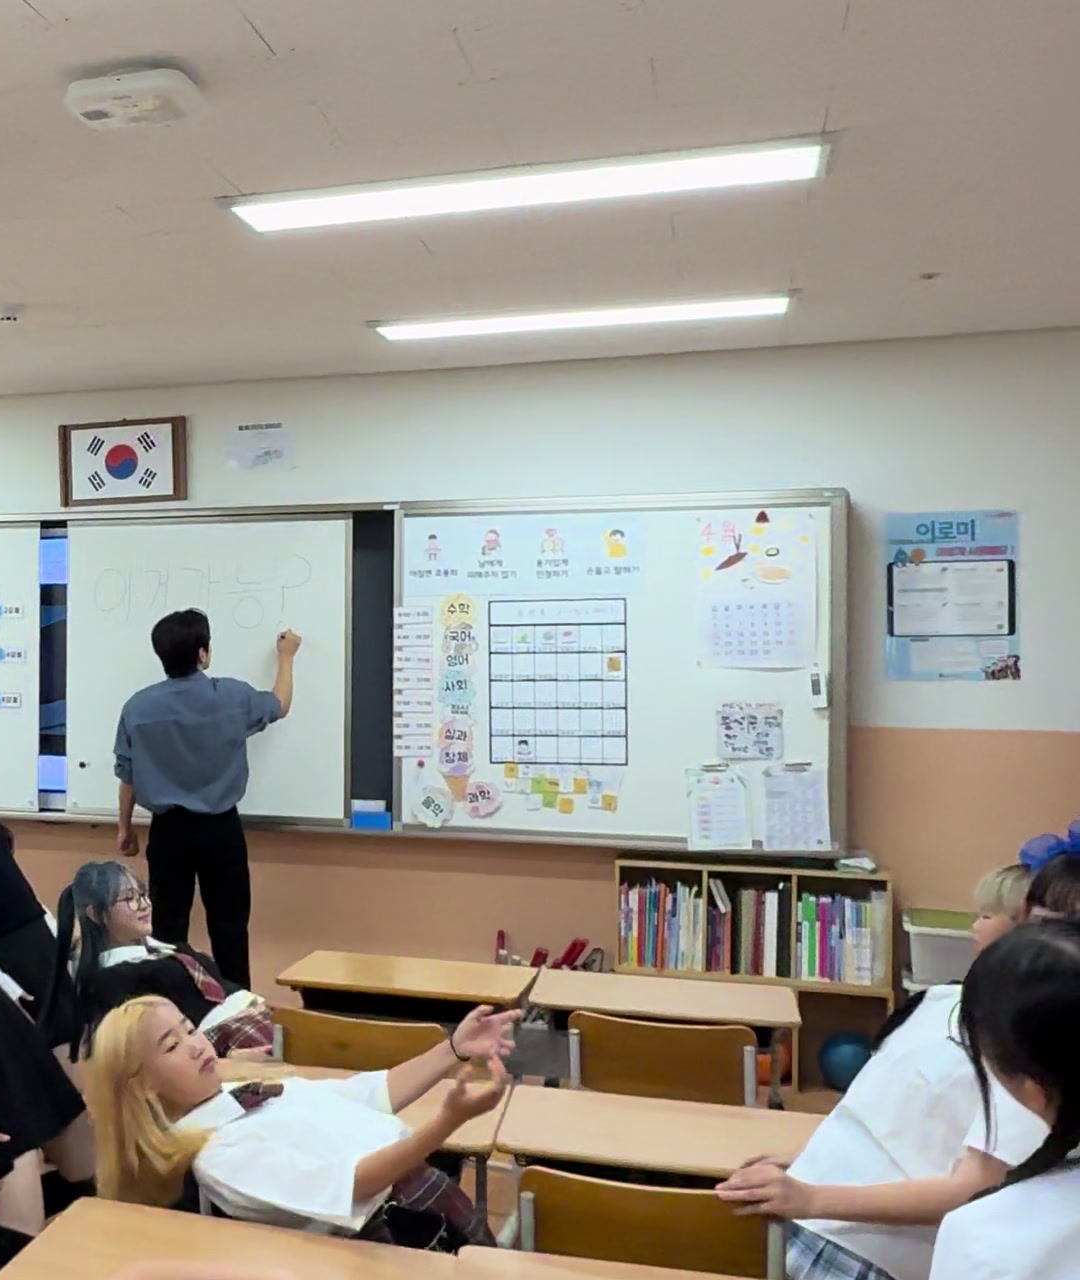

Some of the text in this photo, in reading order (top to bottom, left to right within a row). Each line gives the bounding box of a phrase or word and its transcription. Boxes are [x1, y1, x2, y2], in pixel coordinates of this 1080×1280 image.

[915, 518, 976, 544] 이로미
[447, 602, 471, 615] 수학
[448, 630, 472, 642] 국어
[445, 653, 469, 667] 영어
[444, 679, 468, 692] 사회
[444, 728, 468, 742] 실과
[444, 751, 469, 764] 창체
[467, 789, 491, 804] 과학
